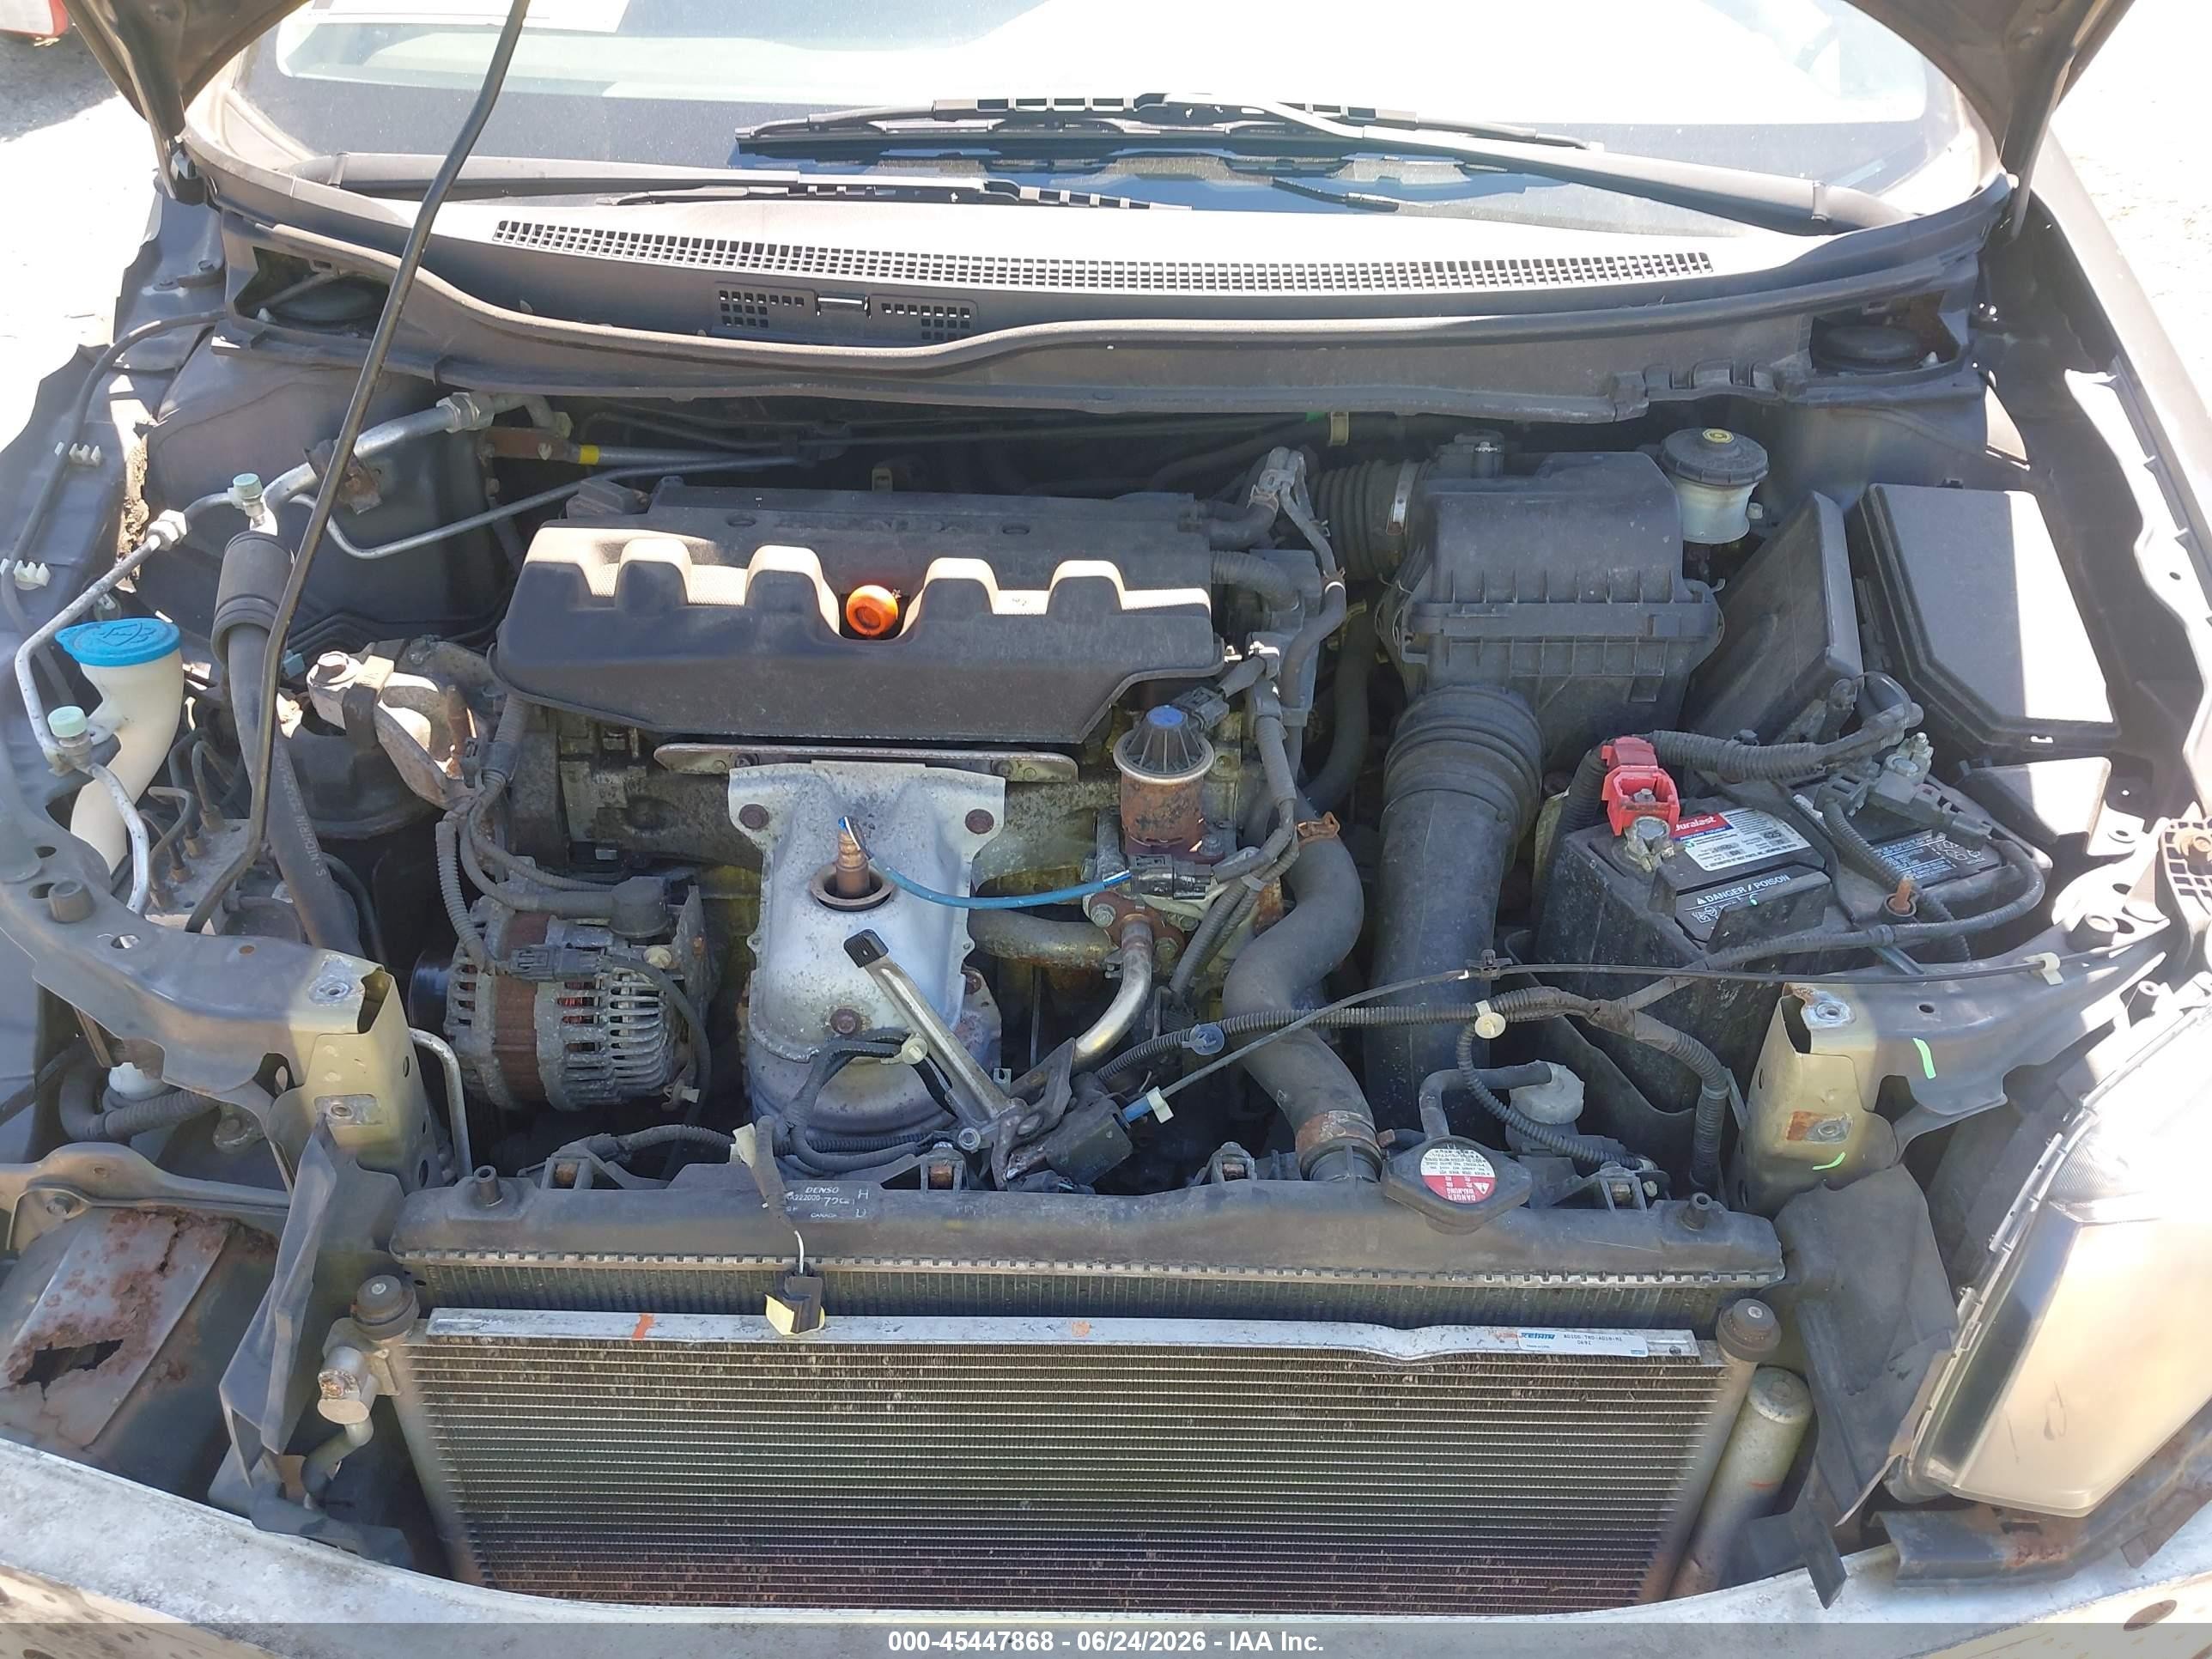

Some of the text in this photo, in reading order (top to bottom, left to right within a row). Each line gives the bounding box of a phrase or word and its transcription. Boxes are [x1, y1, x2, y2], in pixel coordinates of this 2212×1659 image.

[1705, 886, 1747, 902] DANGER
[1753, 874, 1791, 890] POISON
[858, 1188, 869, 1200] H
